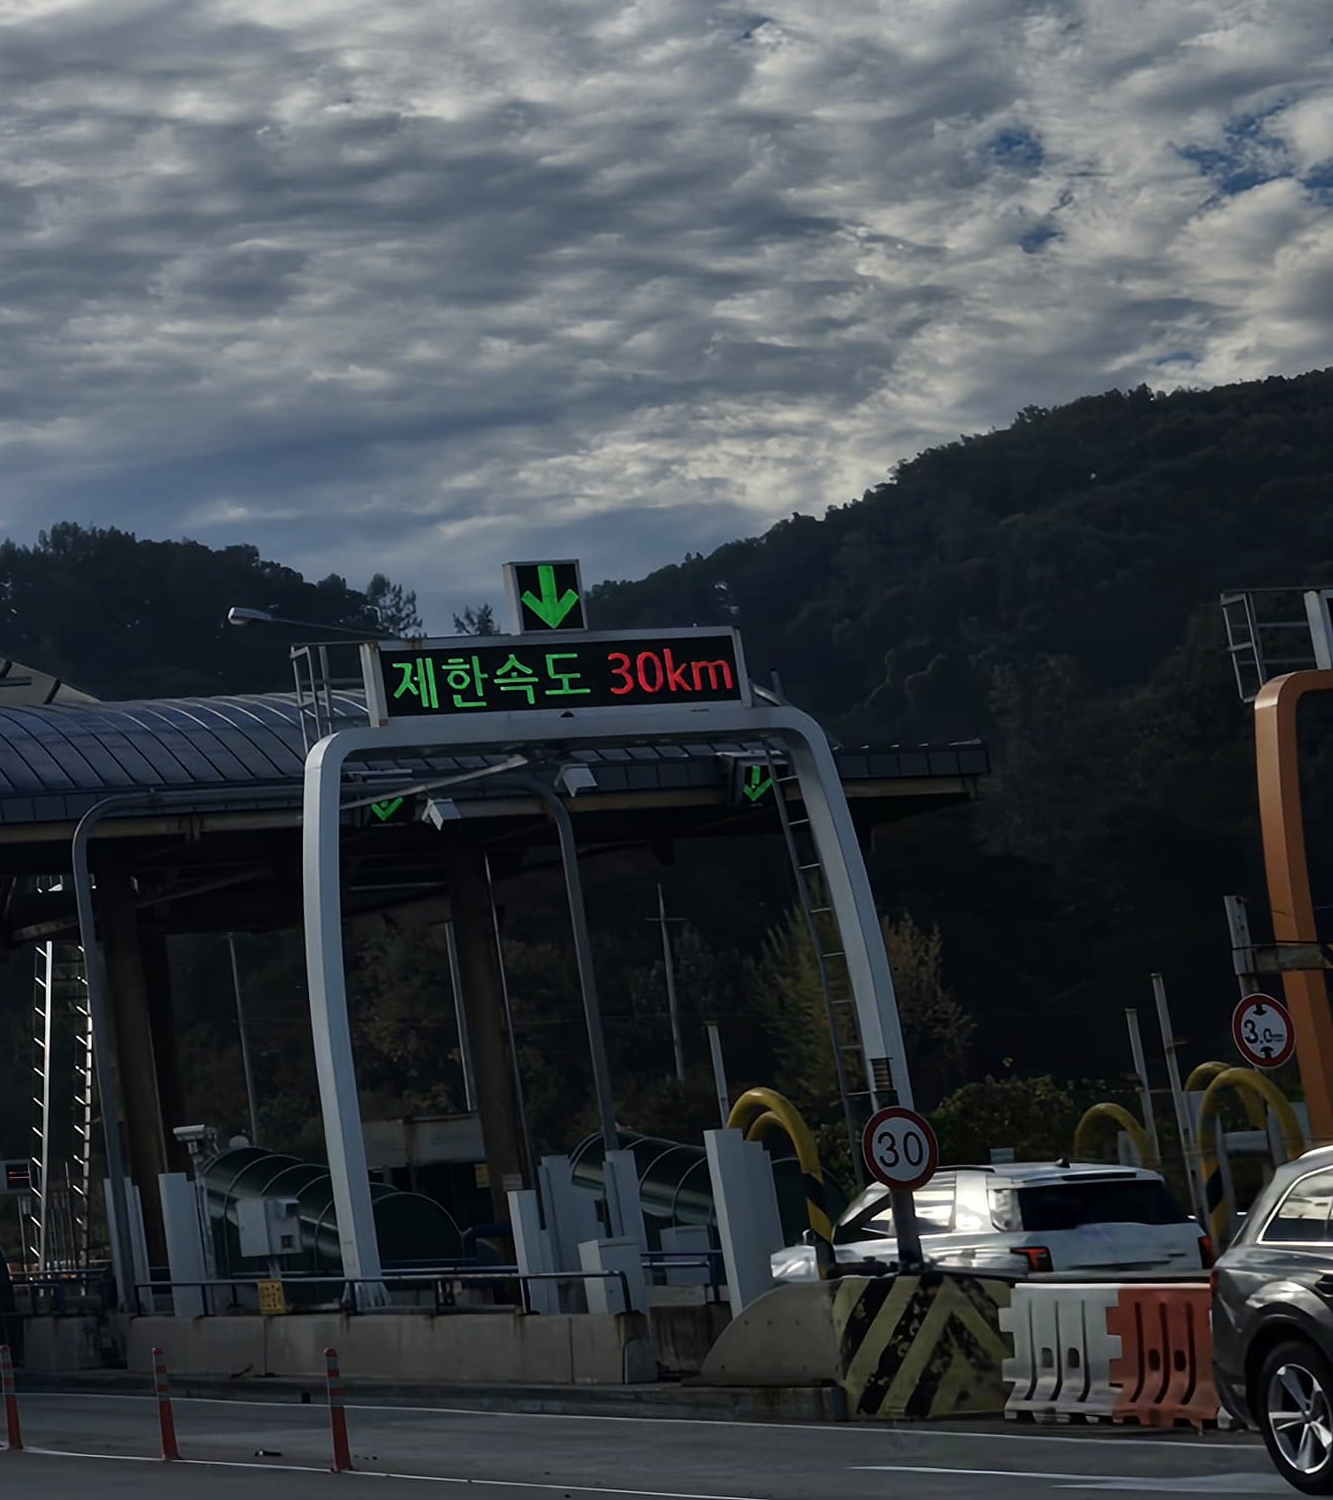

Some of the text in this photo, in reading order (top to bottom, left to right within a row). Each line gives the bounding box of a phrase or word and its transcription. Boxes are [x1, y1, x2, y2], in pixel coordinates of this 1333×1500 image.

[392, 648, 734, 708] 제한속도 30km
[1244, 1019, 1284, 1044] 3.0
[878, 1131, 923, 1167] 30
